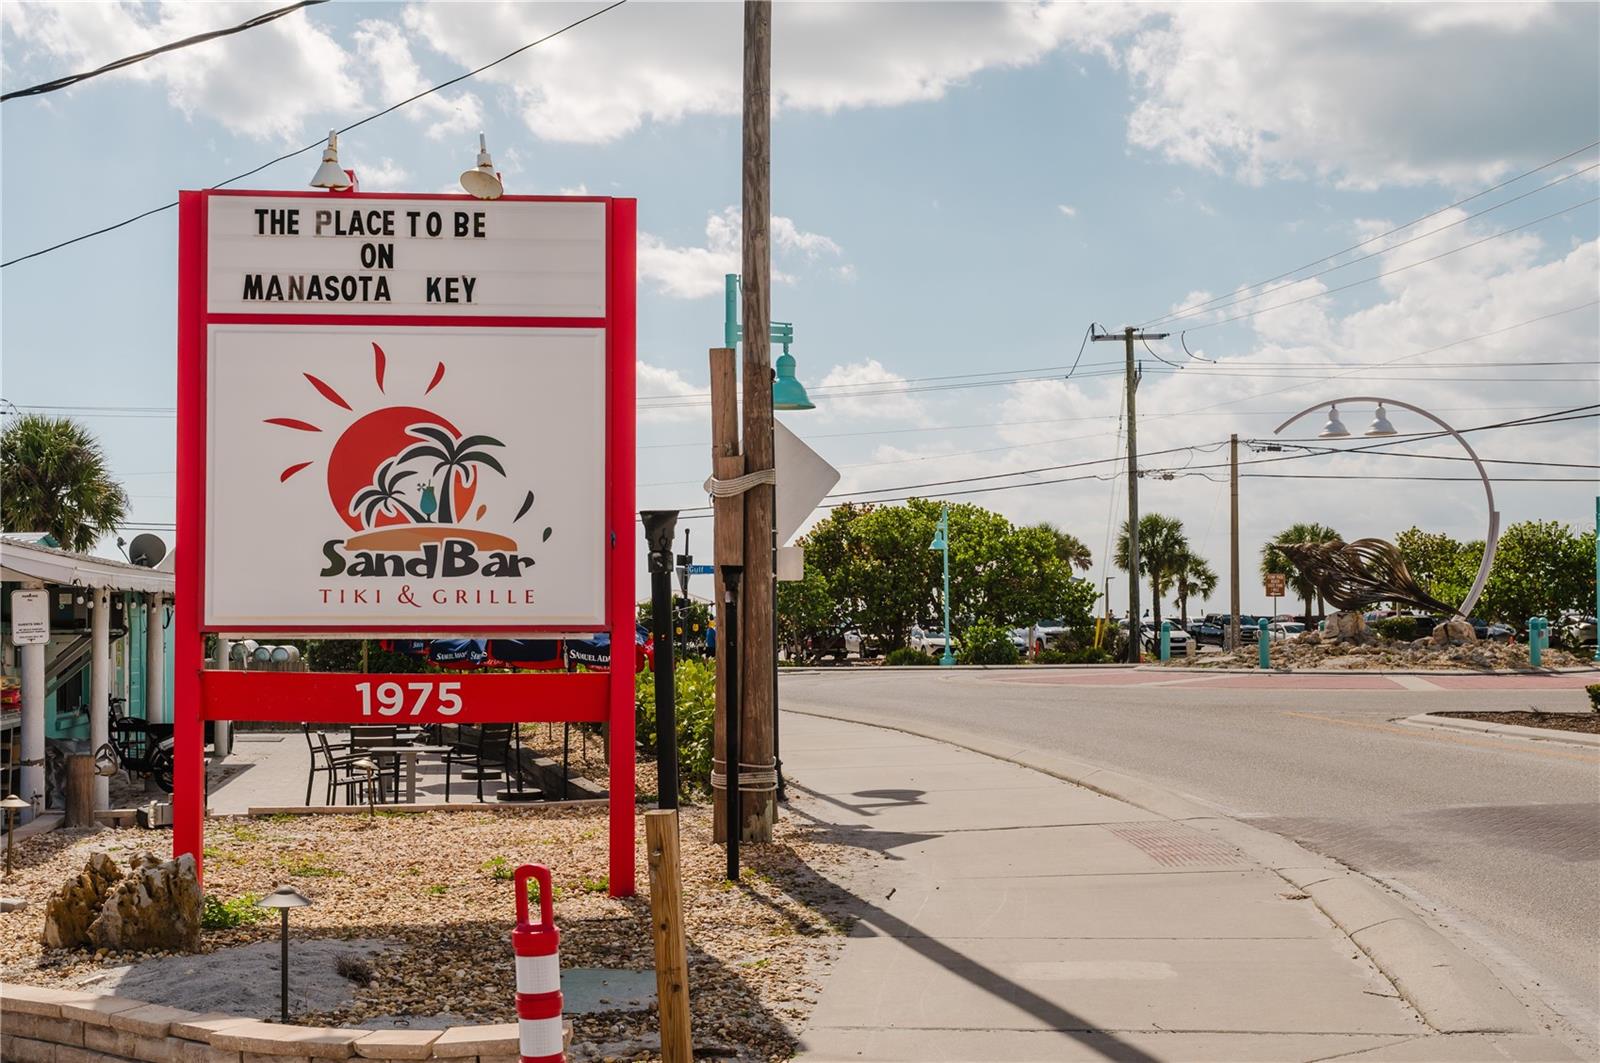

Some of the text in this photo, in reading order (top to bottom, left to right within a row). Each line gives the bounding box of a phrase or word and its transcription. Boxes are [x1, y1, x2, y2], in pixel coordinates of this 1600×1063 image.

[254, 209, 487, 238] THE PLACE TO BE
[360, 243, 395, 270] ON
[242, 274, 477, 303] MANASOTA KEY
[689, 566, 704, 574] Gulf
[319, 585, 536, 608] TIKI & GRILLE
[569, 649, 597, 661] SAMUEL
[355, 682, 463, 717] 1975
